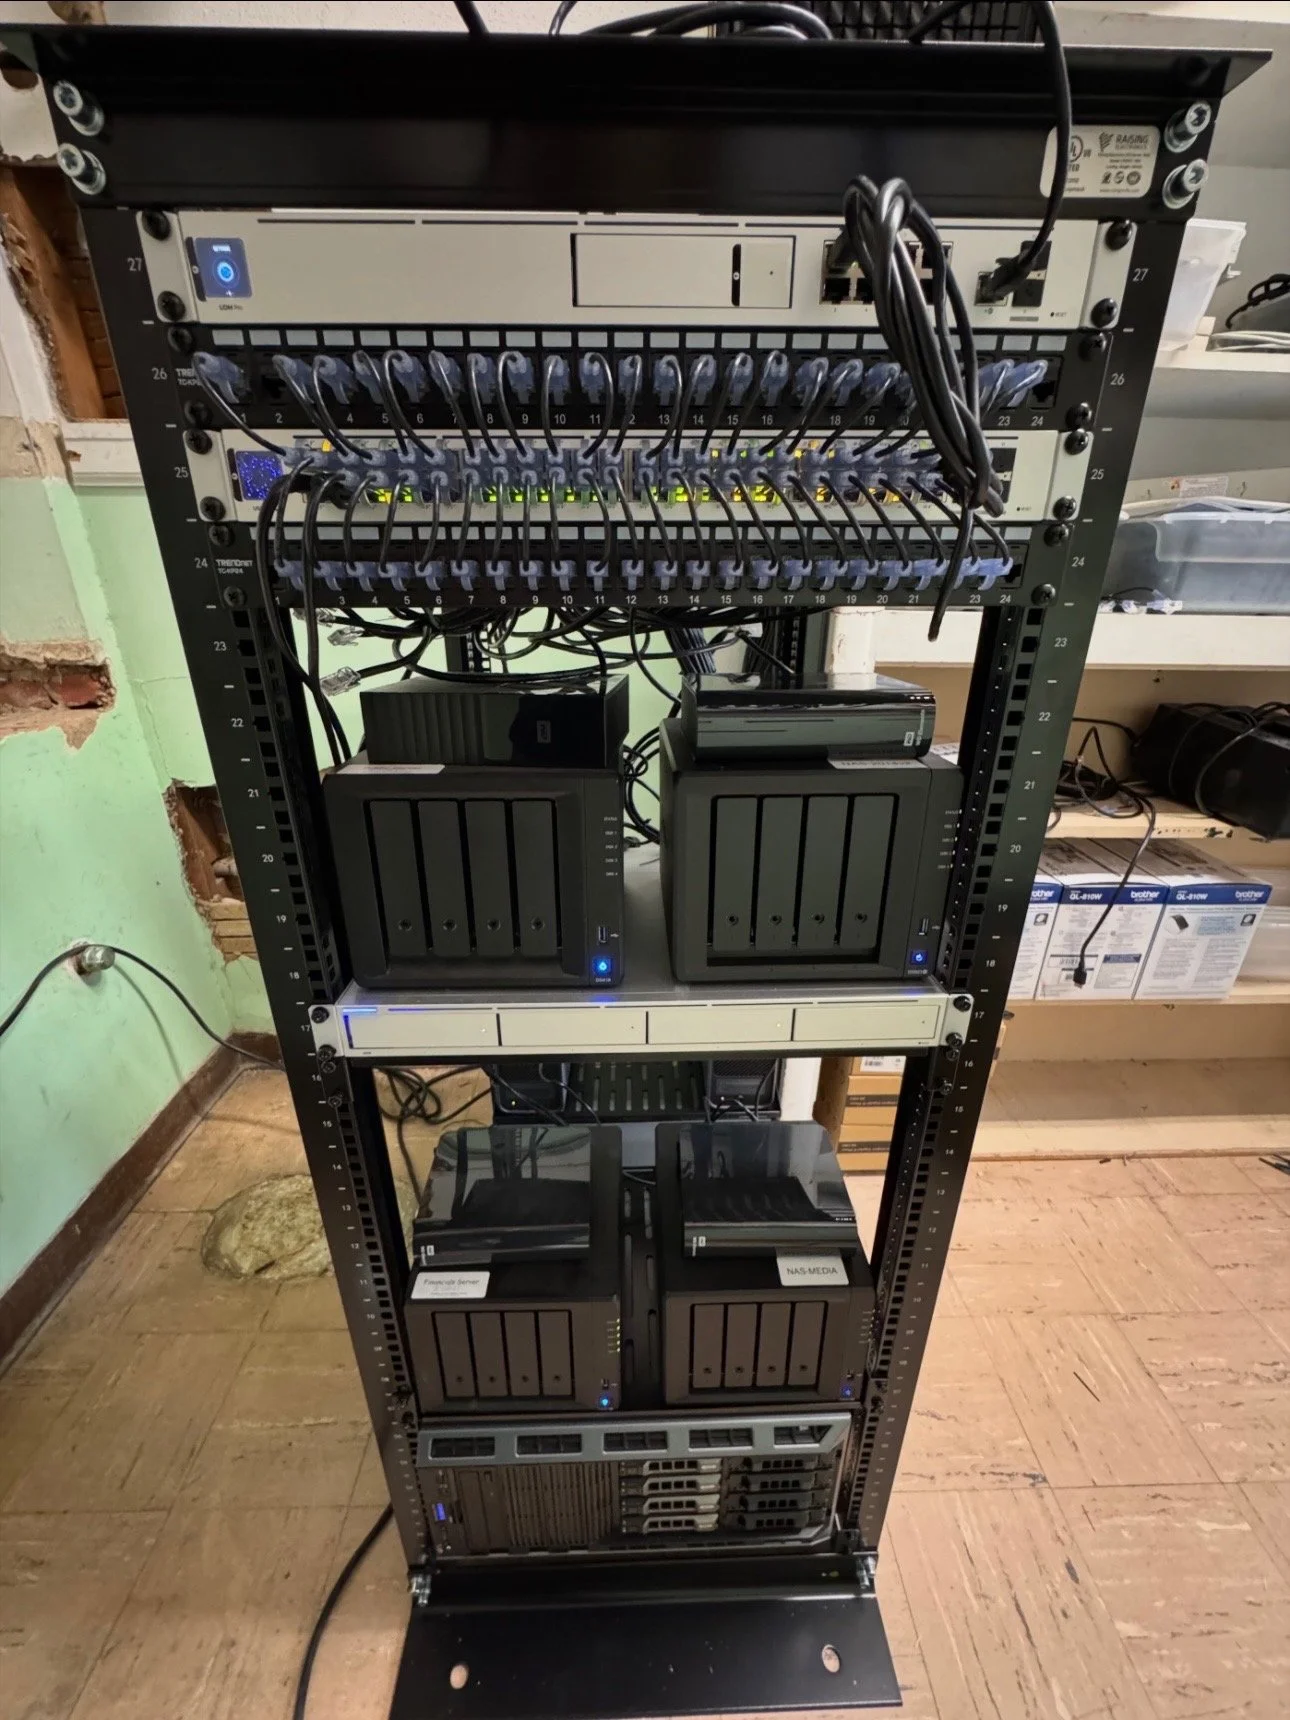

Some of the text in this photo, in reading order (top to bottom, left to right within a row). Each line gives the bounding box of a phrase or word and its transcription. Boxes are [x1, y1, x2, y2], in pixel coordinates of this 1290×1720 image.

[128, 258, 142, 272] 27
[1133, 268, 1148, 282] 27
[152, 368, 168, 380] 26
[1110, 374, 1125, 386] 26
[241, 413, 246, 424] 1
[275, 413, 282, 424] 2
[346, 413, 353, 424] 4
[382, 413, 388, 424] 5
[416, 413, 424, 424] 6
[486, 414, 494, 424] 8
[522, 414, 528, 424] 9
[554, 414, 566, 424] 10
[590, 414, 600, 424] 11
[658, 415, 670, 424] 13
[692, 415, 704, 424] 14
[727, 415, 738, 425] 15
[762, 415, 773, 425] 16
[830, 416, 841, 426] 18
[864, 416, 875, 426] 19
[998, 416, 1010, 426] 23
[1032, 416, 1044, 426] 24
[174, 467, 188, 478] 25
[1090, 469, 1104, 480] 25
[195, 558, 208, 568] 24
[1072, 557, 1085, 567] 24
[276, 594, 1011, 605] 1 3 4 5 6 7 8 9 10 11 12 13 14 15 16 17 18 19 20 21 23 24
[214, 641, 226, 651] 23
[1054, 638, 1068, 648] 23
[1038, 712, 1050, 722] 22
[231, 718, 244, 728] 22
[1024, 780, 1035, 790] 21
[248, 788, 259, 798] 21
[1010, 844, 1021, 854] 20
[262, 854, 274, 863] 20
[1130, 890, 1160, 898] brother
[998, 904, 1008, 912] 19
[276, 915, 286, 924] 19
[986, 960, 996, 968] 18
[289, 972, 300, 980] 18
[312, 1074, 322, 1082] 16
[786, 1267, 838, 1276] NAS-MEDIA
